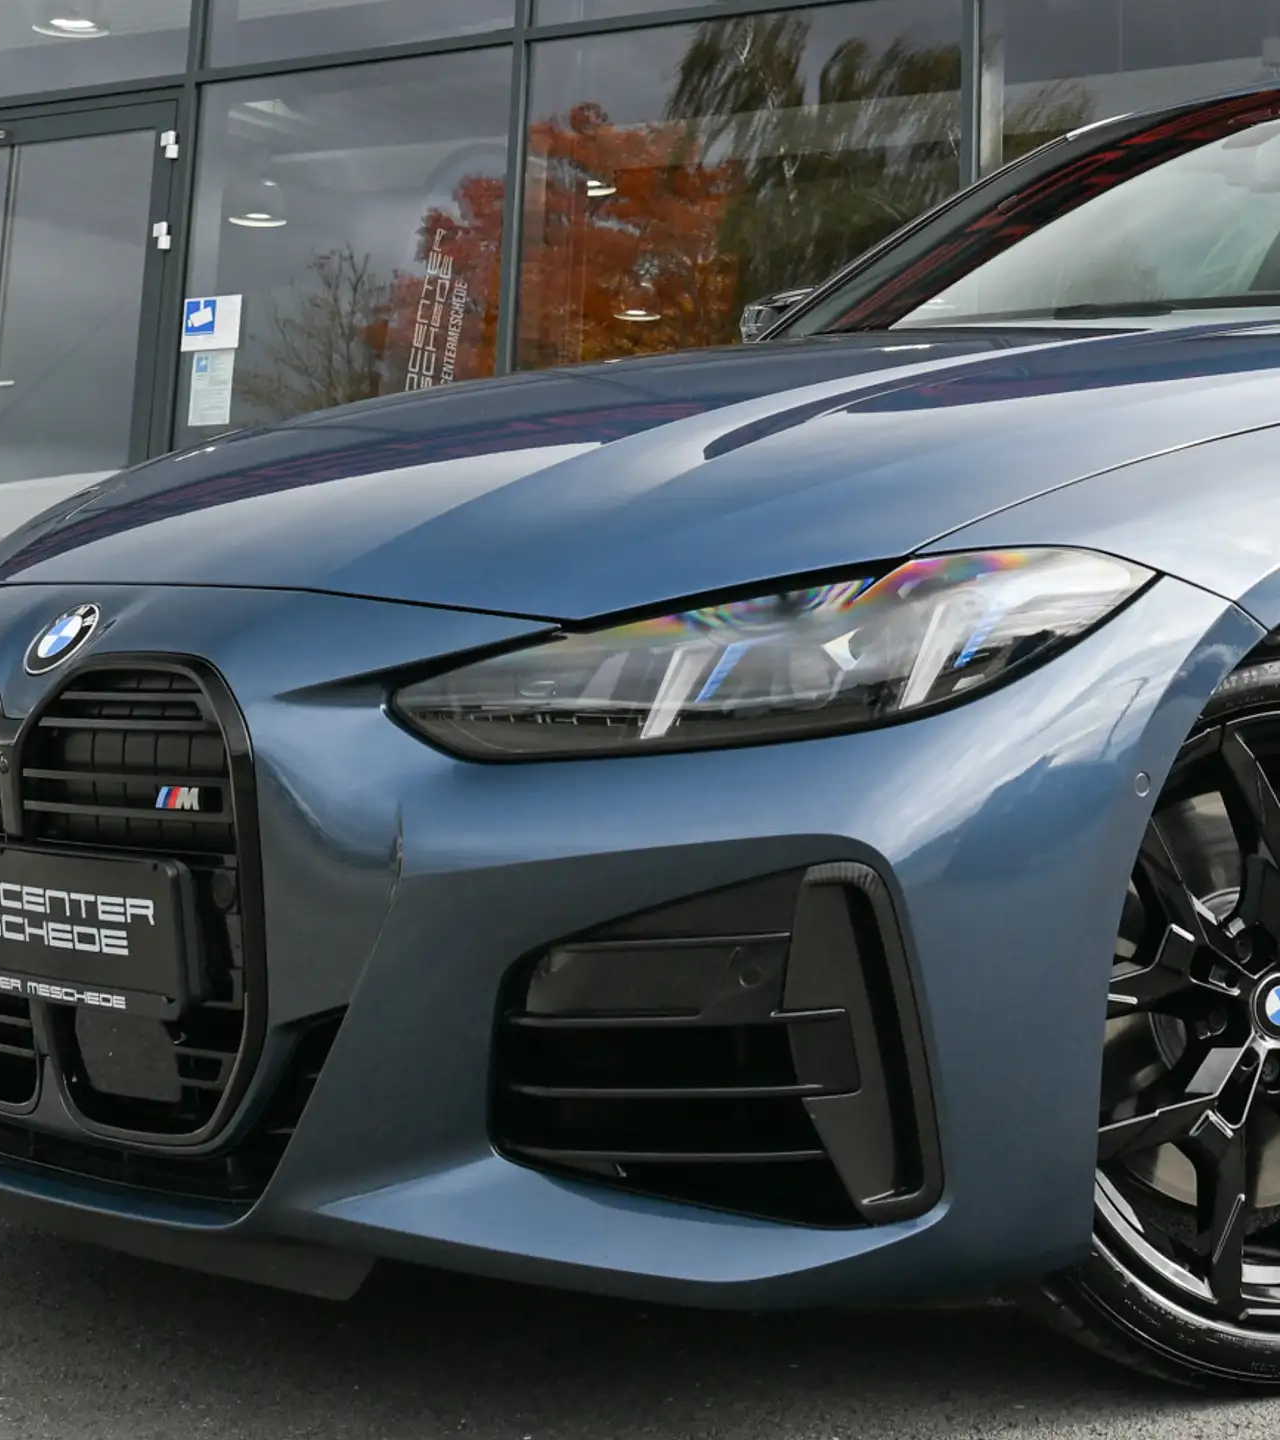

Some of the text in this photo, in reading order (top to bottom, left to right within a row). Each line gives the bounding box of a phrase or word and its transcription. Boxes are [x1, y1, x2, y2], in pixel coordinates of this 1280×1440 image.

[405, 228, 447, 392] OCENTER
[441, 280, 467, 385] CENTERMESCHEDE
[27, 981, 126, 1009] MESCHEDE
